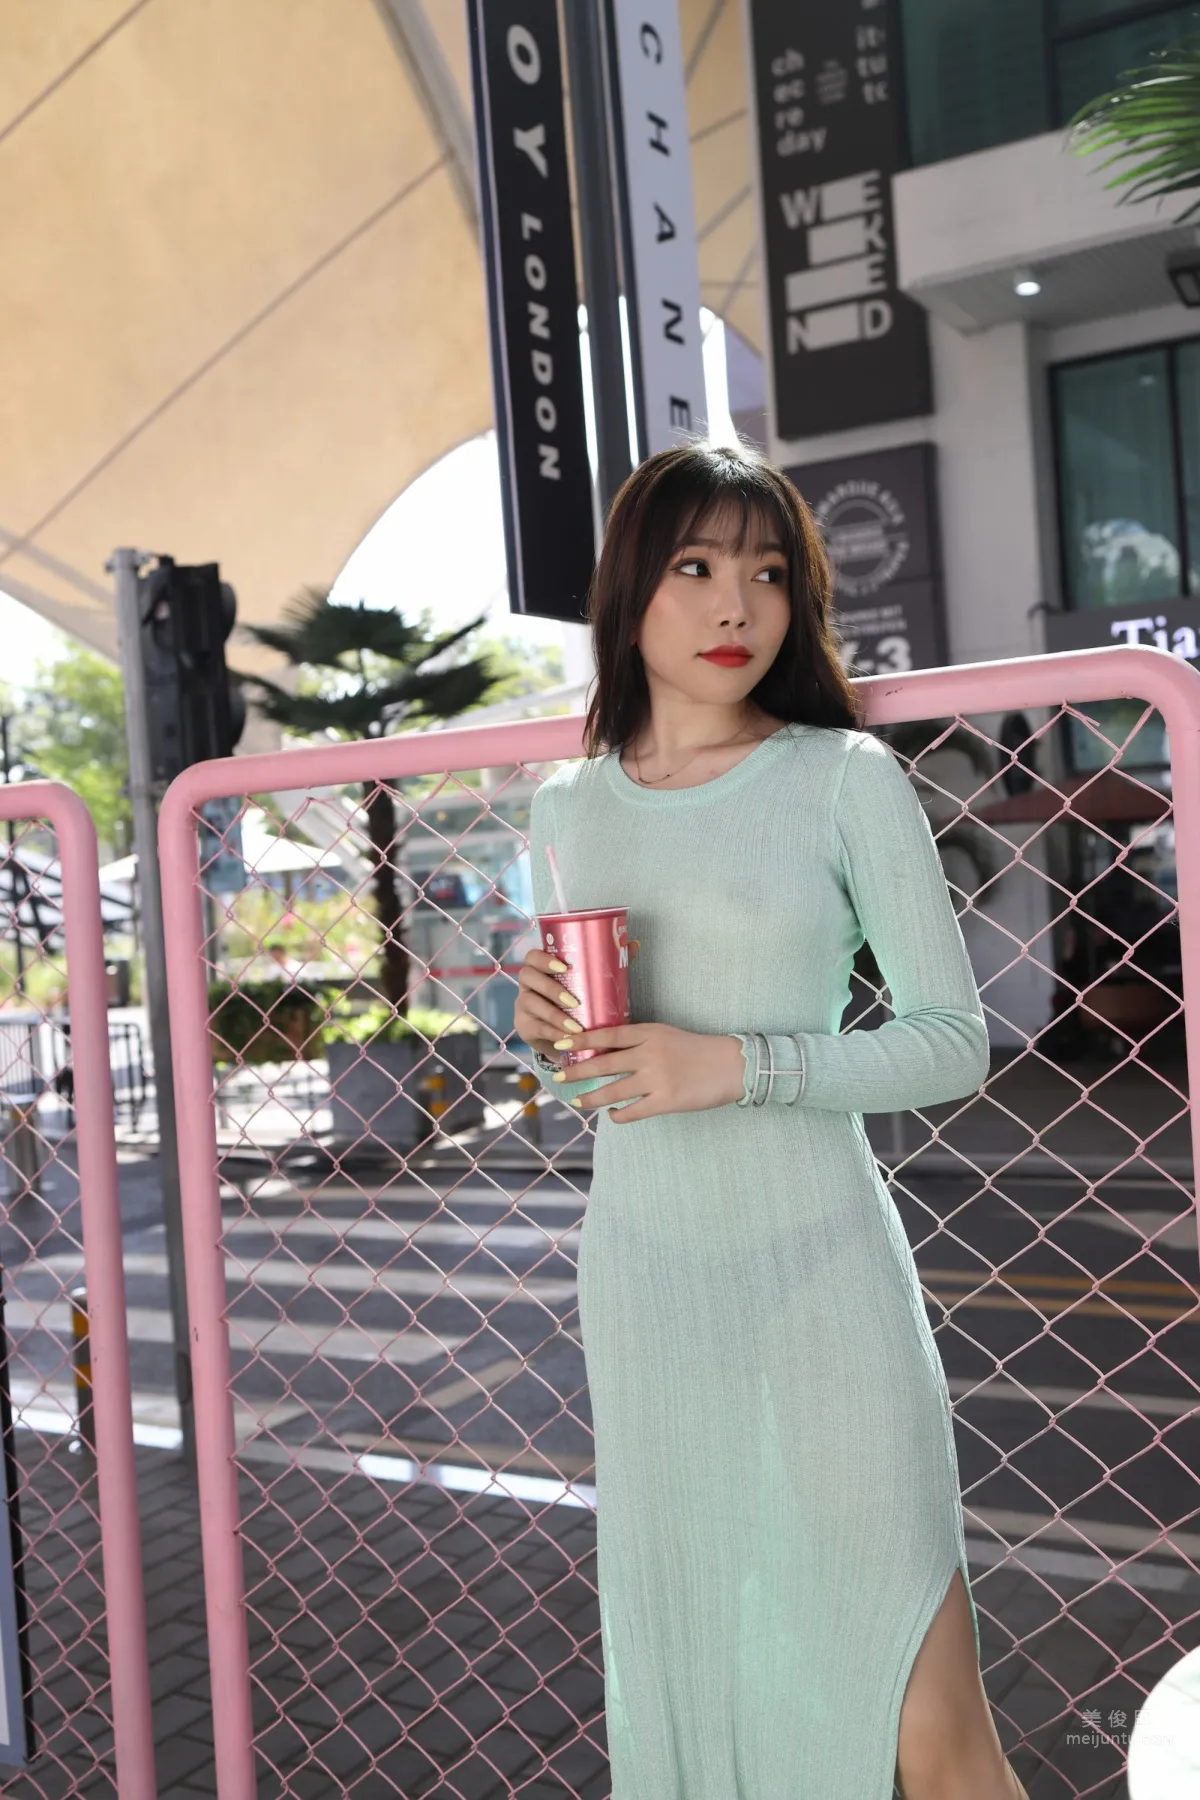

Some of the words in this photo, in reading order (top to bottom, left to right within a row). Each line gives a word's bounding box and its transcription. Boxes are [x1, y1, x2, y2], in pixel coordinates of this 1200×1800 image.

[776, 126, 827, 157] day
[521, 212, 561, 480] LONDON
[1111, 615, 1200, 659] Tia
